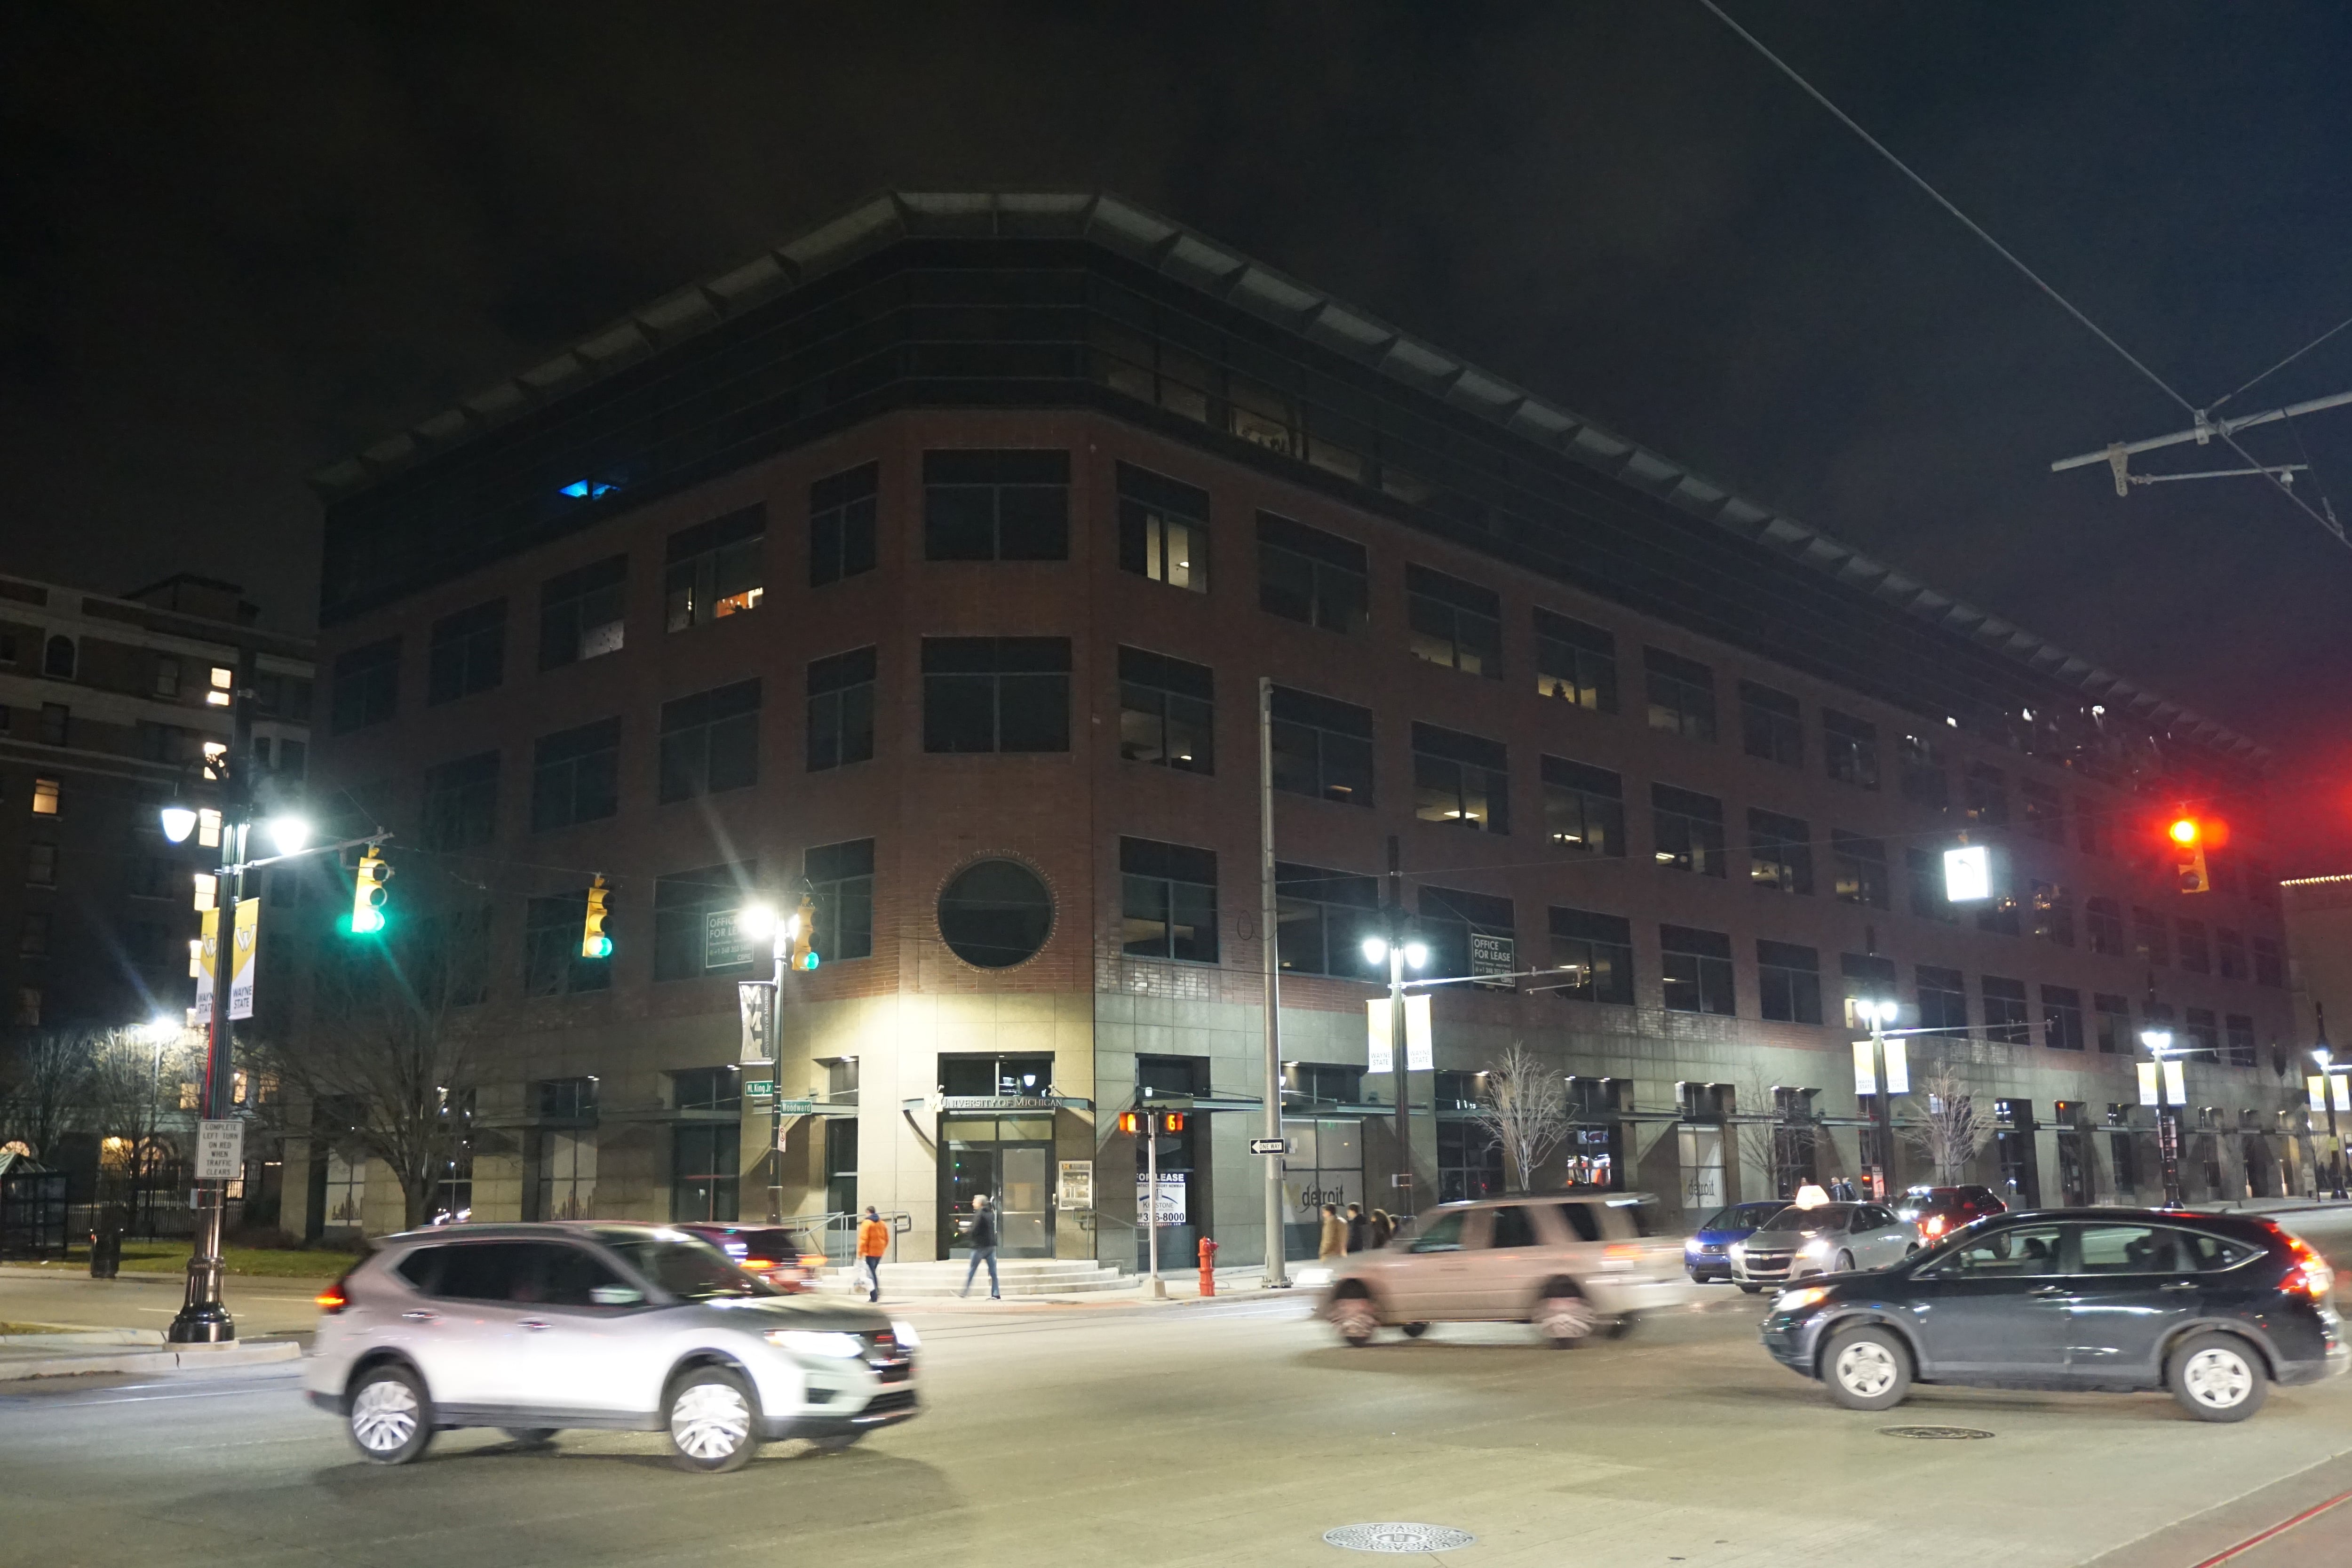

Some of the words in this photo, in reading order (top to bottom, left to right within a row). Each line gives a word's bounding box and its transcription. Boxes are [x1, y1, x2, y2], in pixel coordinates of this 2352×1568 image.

[710, 916, 737, 927] OFFIC
[710, 928, 726, 939] FOR
[1474, 939, 1499, 950] OFFICE
[1475, 949, 1489, 959] FOR
[1490, 951, 1511, 962] LEASE
[198, 992, 213, 1002] WAYN
[233, 986, 253, 997] WAYNE
[199, 1003, 212, 1014] STAT
[234, 997, 250, 1009] STATE
[754, 1084, 765, 1093] King
[765, 1083, 772, 1092] Jr
[941, 1099, 997, 1107] UNIVERSITY
[1014, 1097, 1062, 1106] MICHIGAN
[1144, 1213, 1184, 1221] 36-8000
